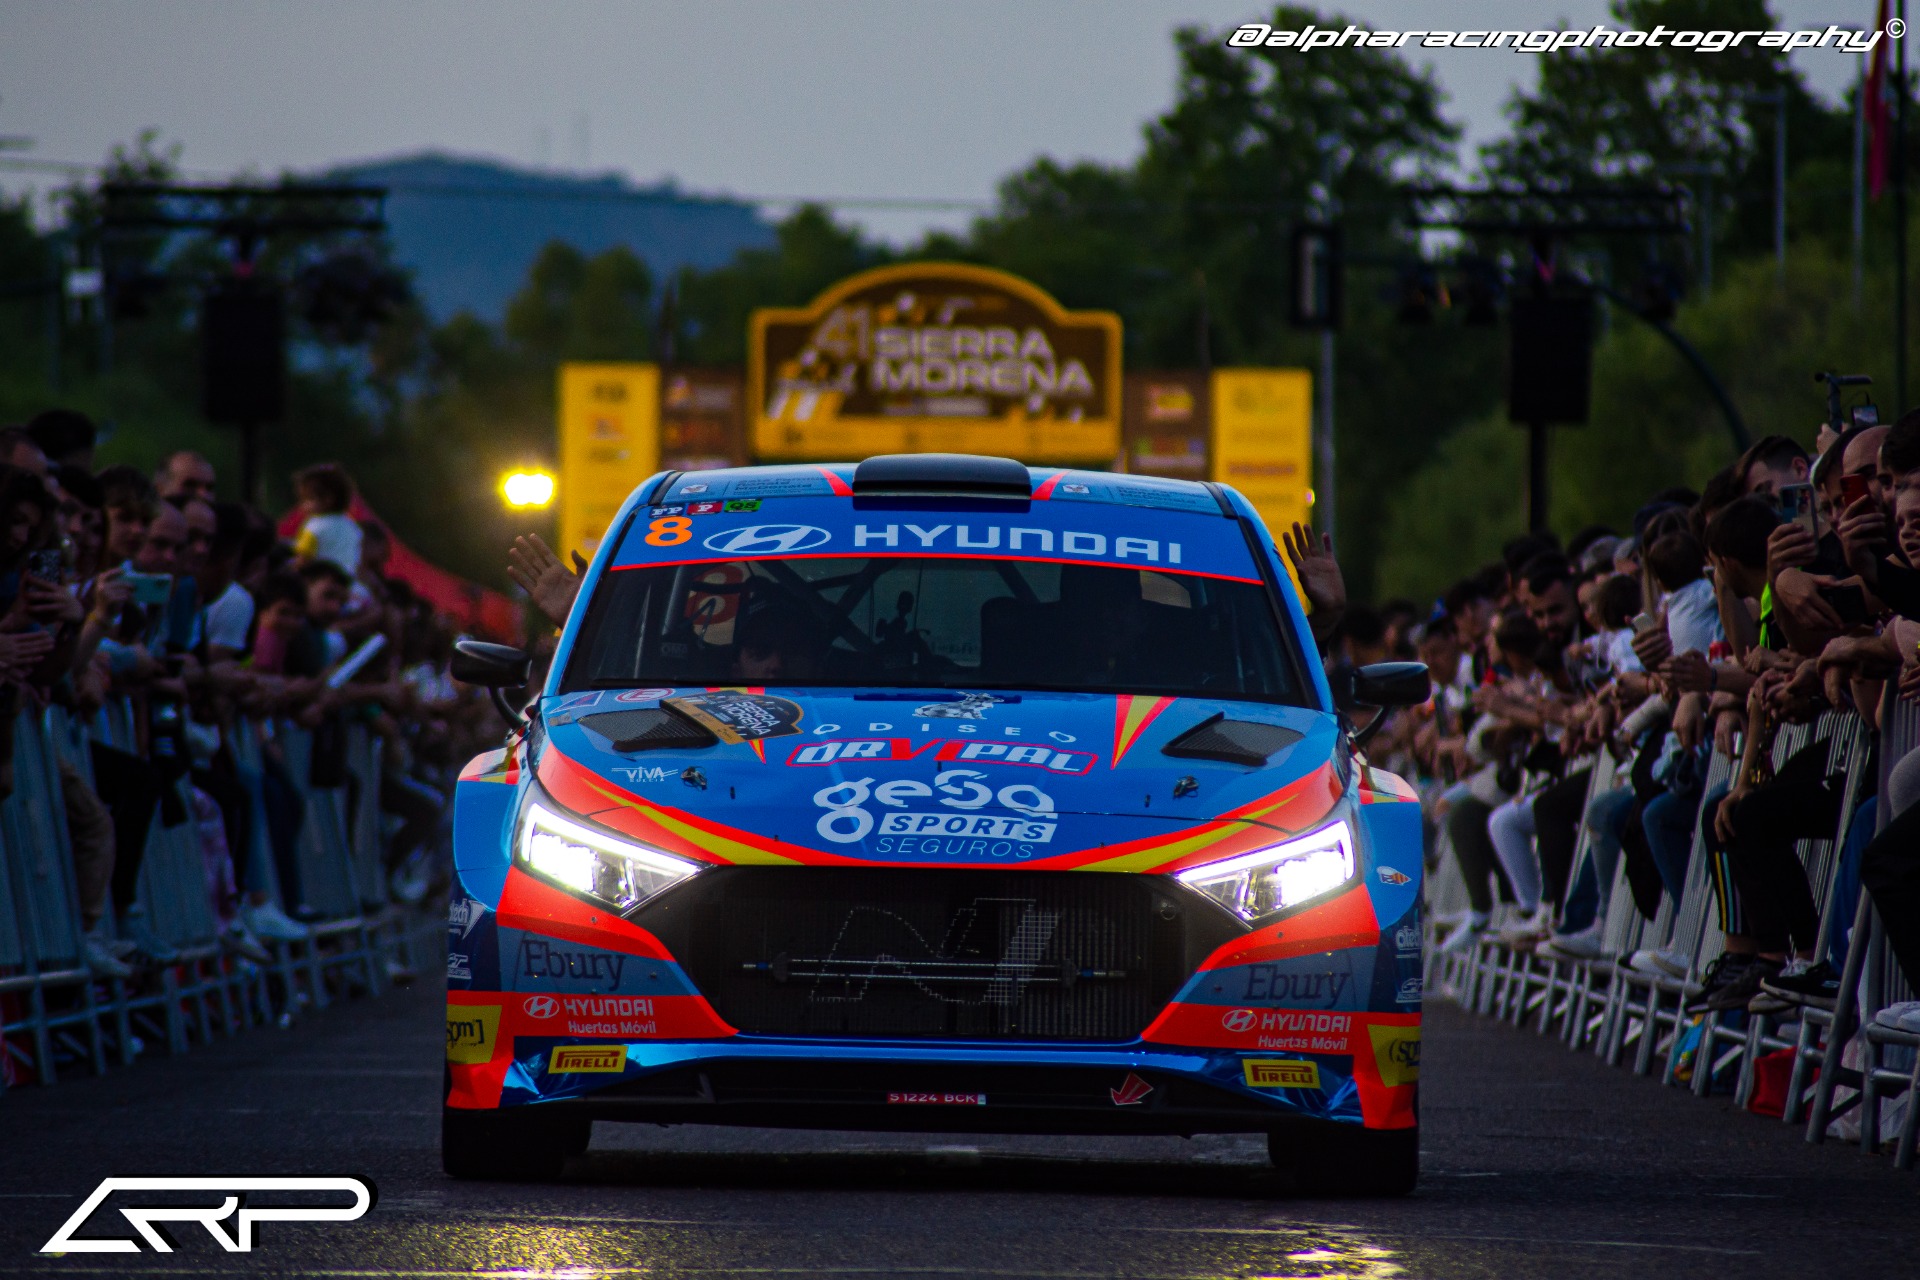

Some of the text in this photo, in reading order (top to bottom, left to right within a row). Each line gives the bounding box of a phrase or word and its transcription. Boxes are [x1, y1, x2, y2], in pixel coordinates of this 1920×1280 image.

[875, 326, 1055, 360] SIERRA
[872, 359, 1095, 398] MORENA
[652, 506, 683, 516] FP
[698, 504, 713, 512] P
[645, 516, 693, 547] 8
[853, 524, 1182, 564] HYUNDAI
[718, 703, 772, 735] MORENA
[735, 701, 781, 727] SIERRA
[796, 739, 1081, 773] ORVIPAL
[626, 766, 664, 779] VIVA
[889, 815, 1047, 840] SPORTS
[876, 837, 1034, 858] SEGUROS
[521, 939, 627, 991] Ebury
[1243, 963, 1352, 1009] Ebury
[562, 998, 654, 1017] HYUNDAI
[568, 1019, 656, 1034] Huertas Móvil
[1261, 1013, 1351, 1033] HYUNDAI
[1258, 1034, 1348, 1051] Huertas Móvil
[555, 1050, 620, 1069] PIRELLI
[1251, 1064, 1313, 1084] PIRELLI
[944, 1093, 976, 1103] BCK
